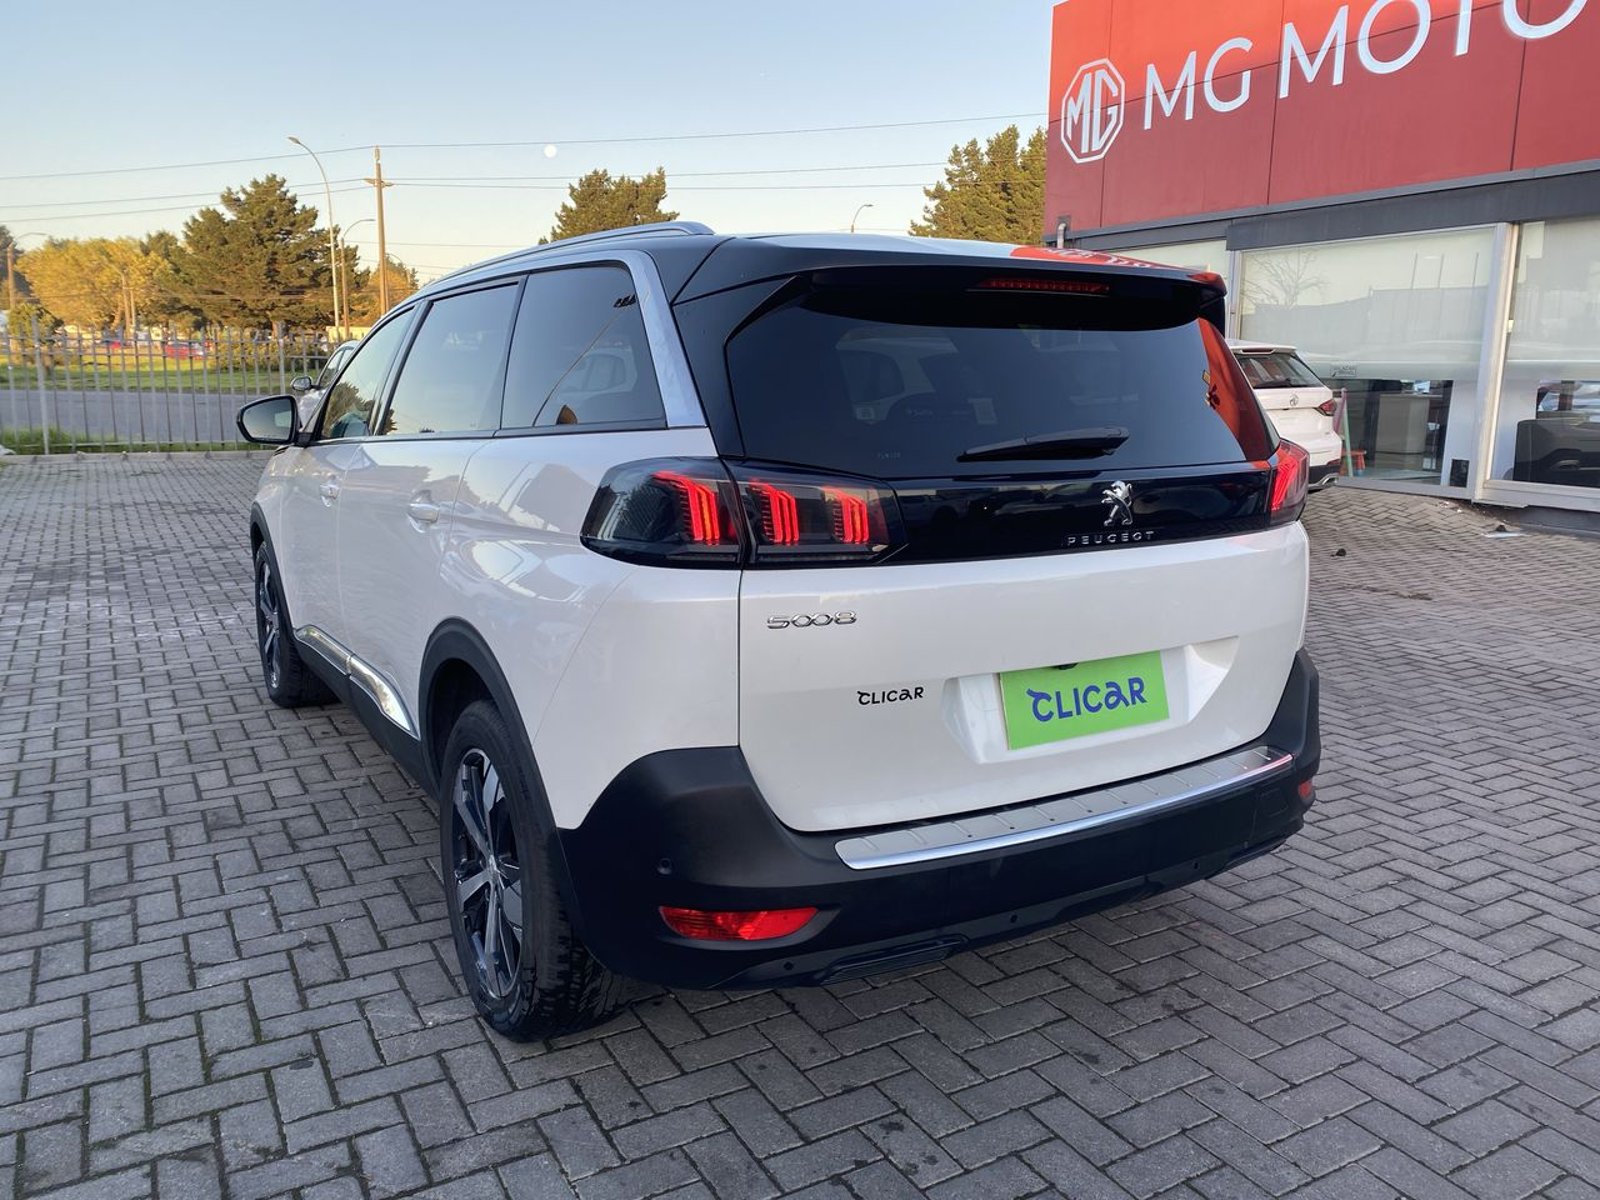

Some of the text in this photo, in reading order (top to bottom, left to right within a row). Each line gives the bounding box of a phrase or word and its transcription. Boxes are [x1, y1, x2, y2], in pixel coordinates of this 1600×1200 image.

[1144, 37, 1253, 131] MG
[1065, 68, 1120, 154] MG
[1067, 530, 1154, 546] PEUGEOT
[766, 610, 857, 630] 5008
